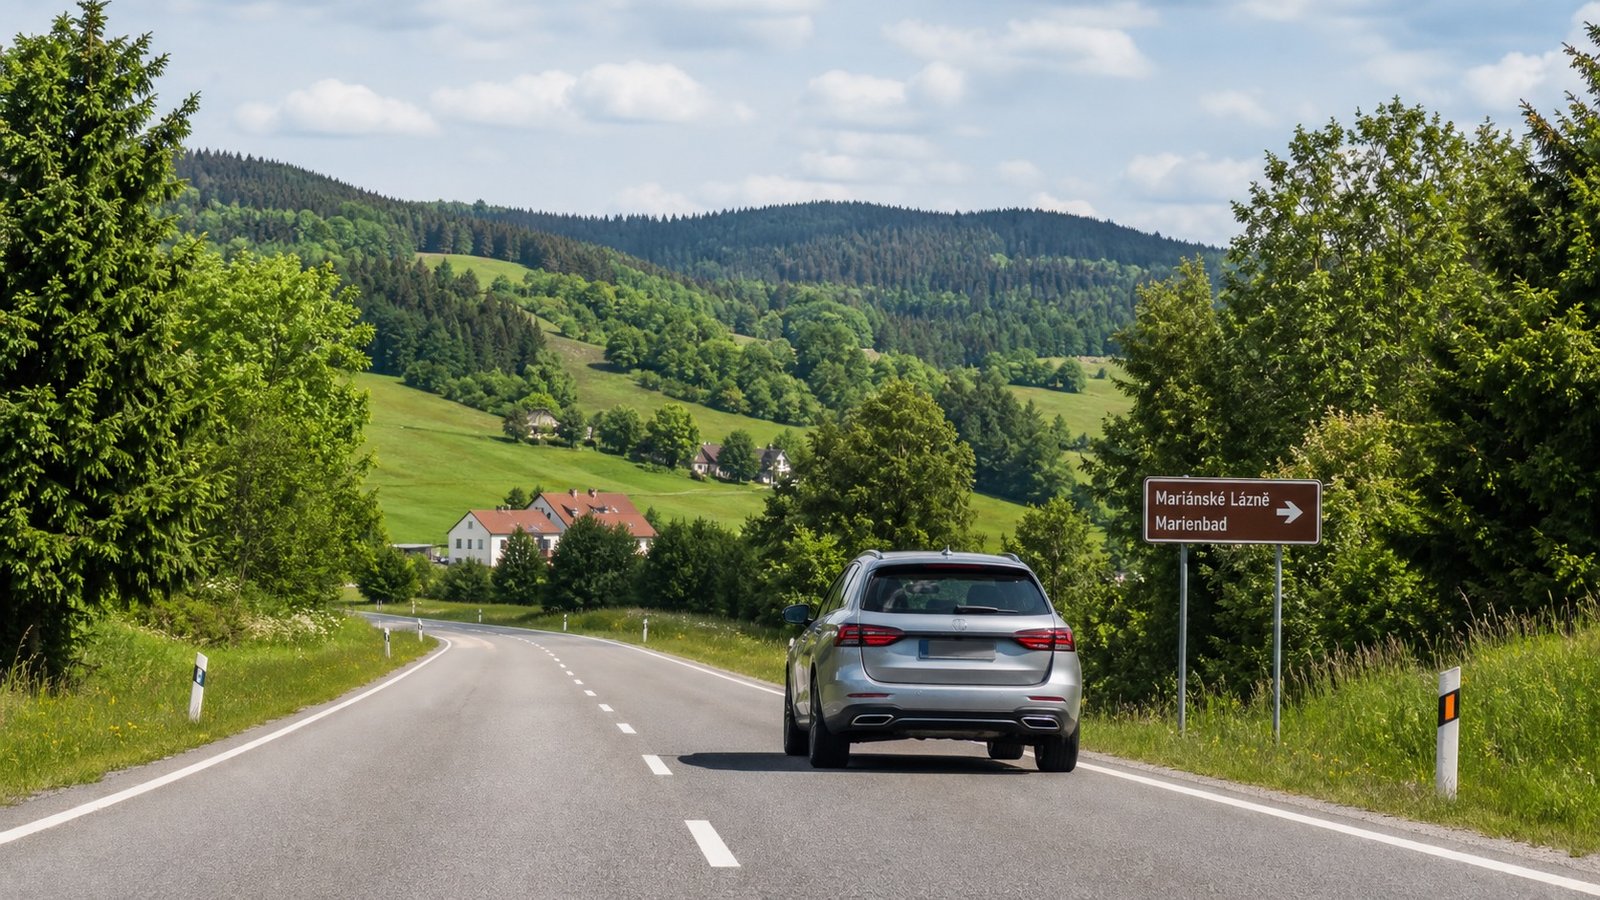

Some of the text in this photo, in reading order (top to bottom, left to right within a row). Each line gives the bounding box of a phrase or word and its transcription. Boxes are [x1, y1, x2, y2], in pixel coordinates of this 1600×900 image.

[1155, 490, 1270, 507] Mariánské Lázně
[1155, 515, 1227, 531] Marienbad
